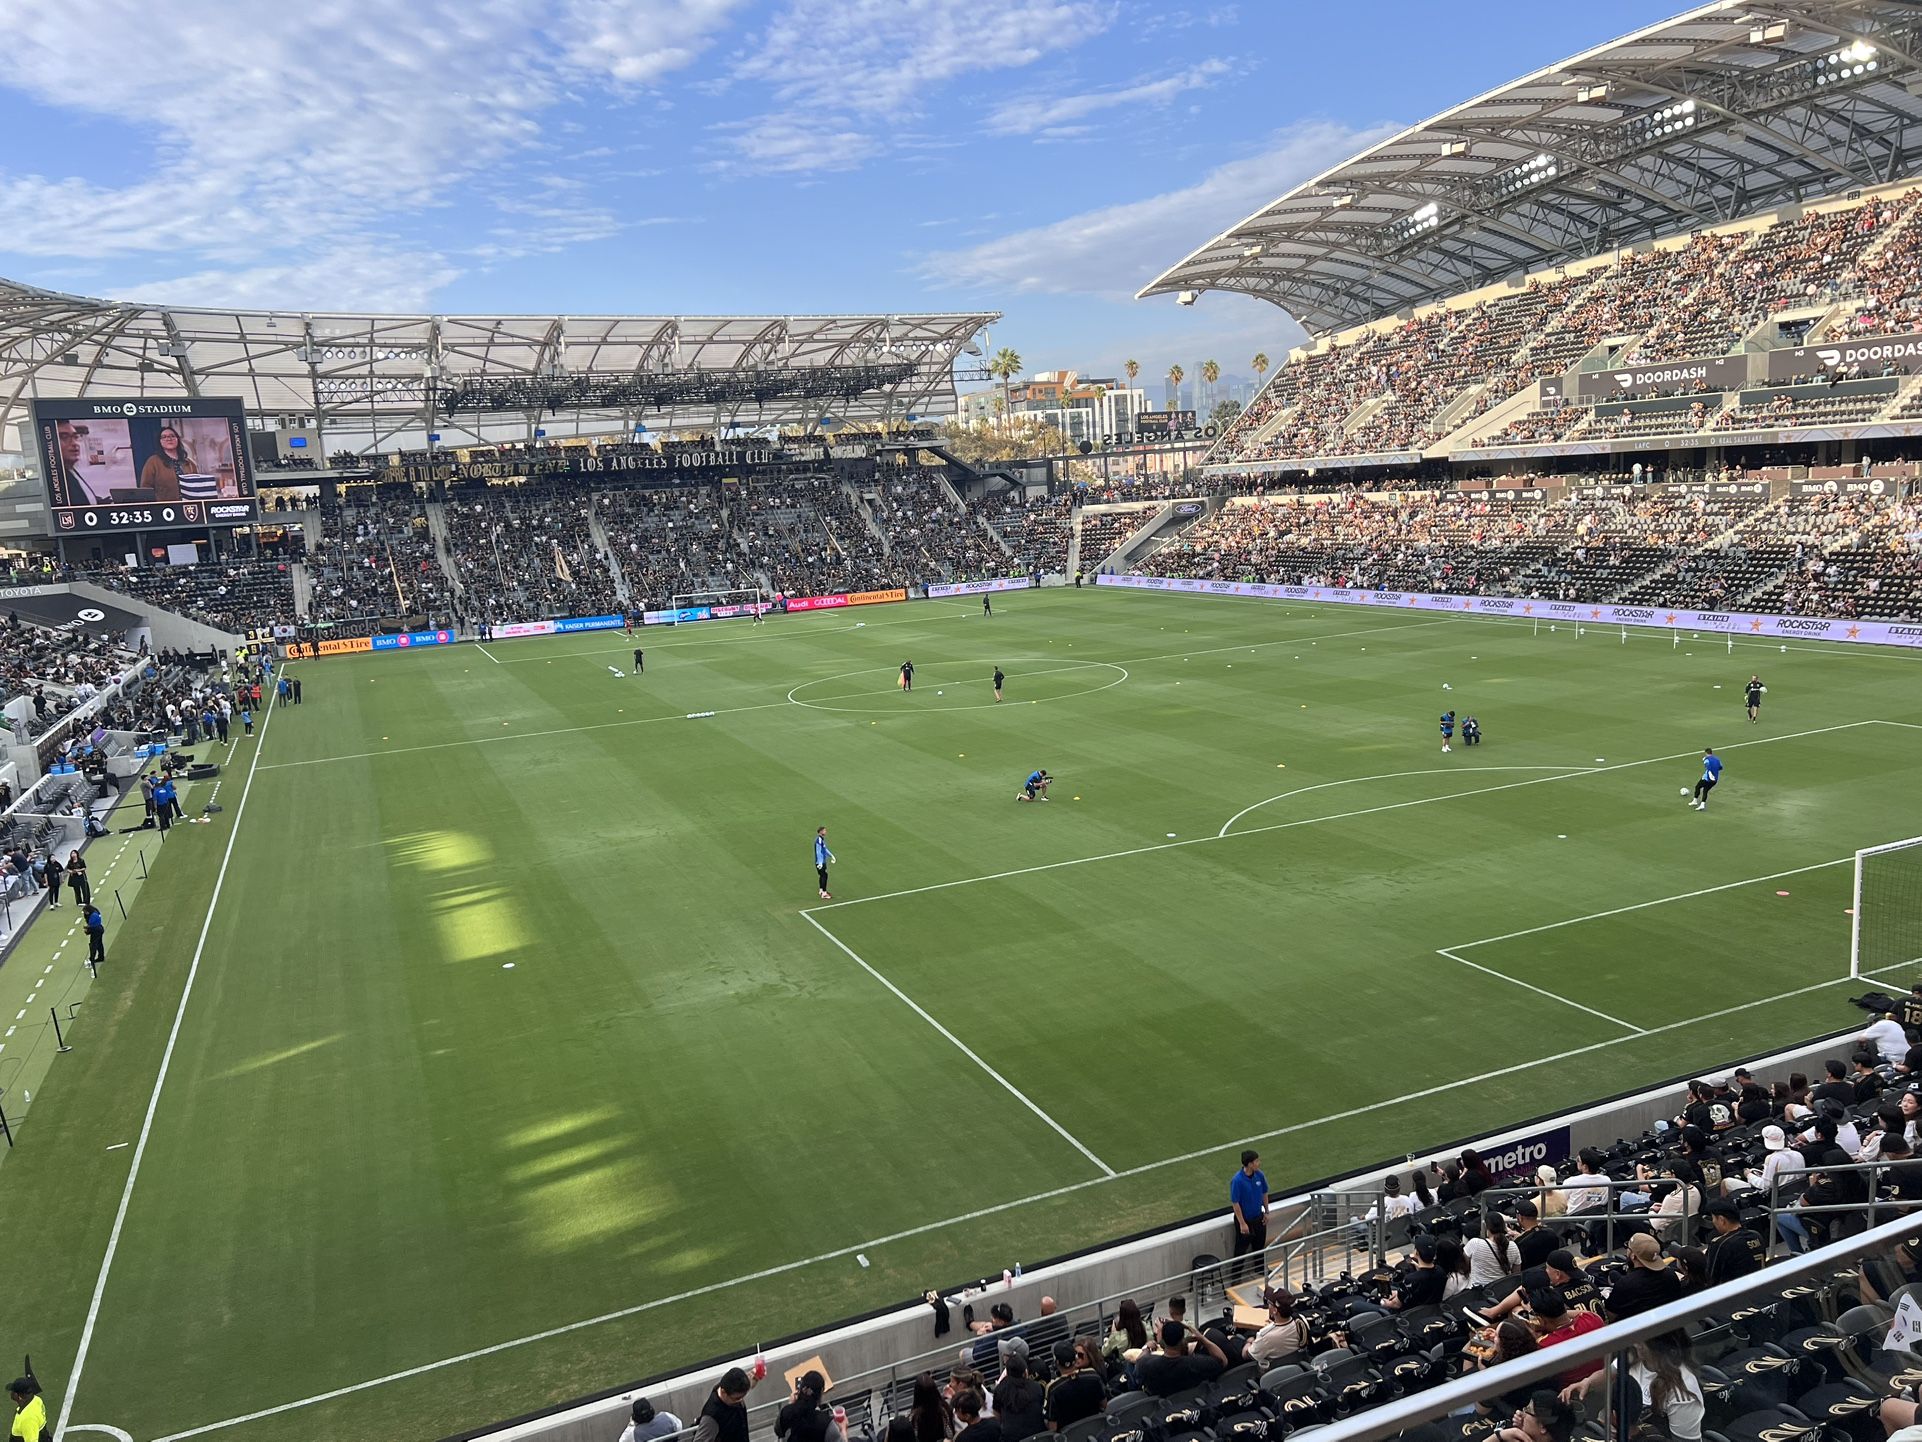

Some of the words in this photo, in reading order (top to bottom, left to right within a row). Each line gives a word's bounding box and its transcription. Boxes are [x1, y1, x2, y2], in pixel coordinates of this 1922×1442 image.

[1636, 366, 1707, 384] DOORDASH
[93, 405, 121, 414] BMO
[138, 405, 192, 413] STADIUM
[579, 457, 604, 472] LOS
[611, 455, 668, 471] ANGELES
[674, 451, 738, 468] FOOTBALL
[1802, 484, 1823, 492] BMO
[1846, 483, 1869, 491] BMO
[210, 504, 250, 514] ROCKSTAR
[84, 511, 98, 526] 0
[110, 510, 152, 525] 32:35
[162, 507, 175, 522] 0
[0, 587, 42, 598] TOYOTA
[890, 591, 904, 599] Tire
[789, 600, 809, 608] Audi
[1479, 599, 1514, 609] ROCKSTAR
[1612, 607, 1655, 619] ROCKSTAR
[565, 622, 584, 630] KAISER
[584, 619, 620, 629] PERMANENTE
[1776, 619, 1831, 632] ROCKSTAR
[1891, 627, 1922, 635] STAIN
[376, 638, 396, 646] BMO
[415, 634, 435, 642] BMO
[348, 640, 370, 649] Tire
[1483, 1142, 1546, 1174] metro
